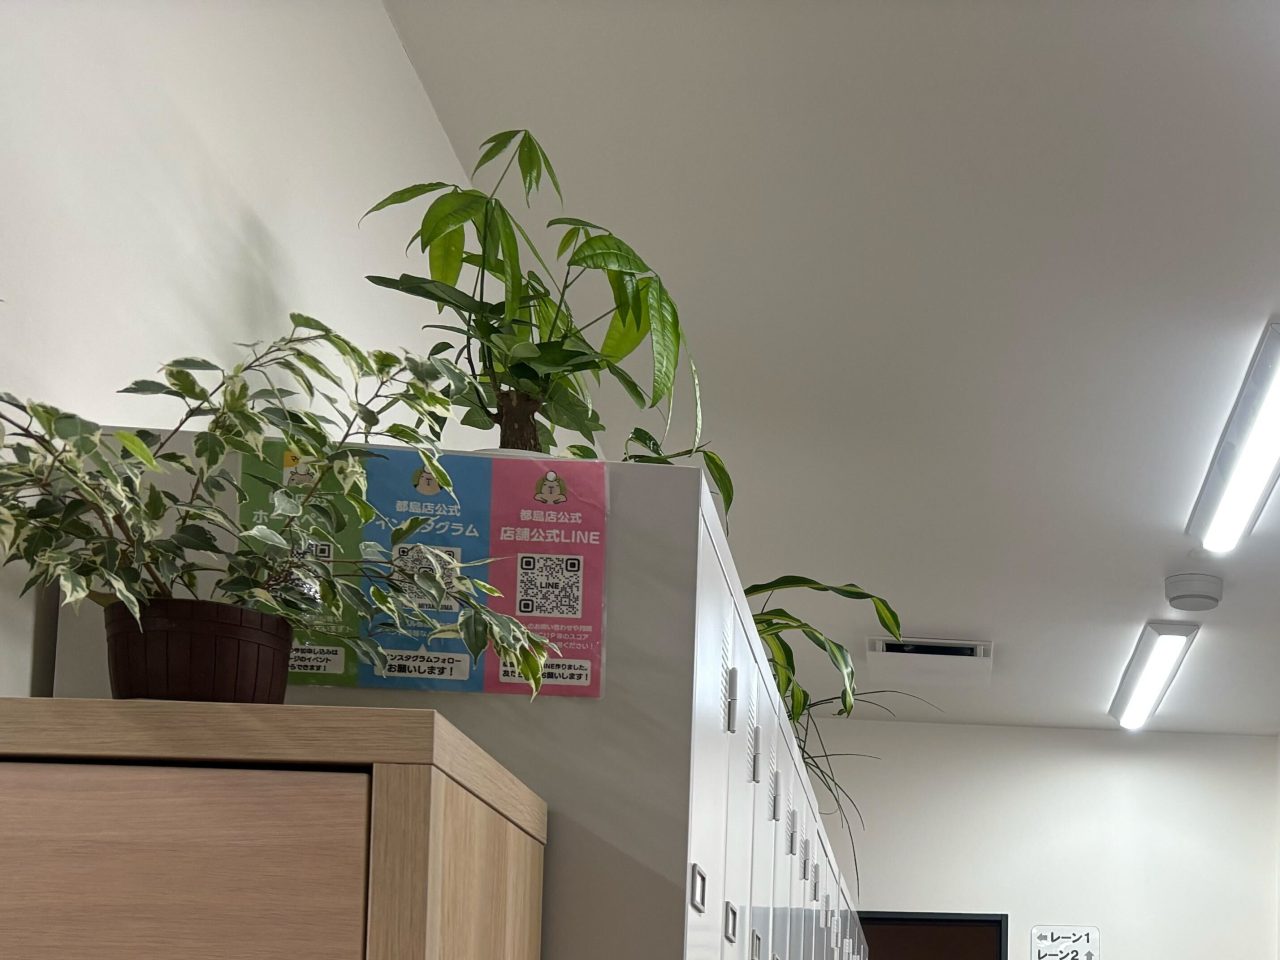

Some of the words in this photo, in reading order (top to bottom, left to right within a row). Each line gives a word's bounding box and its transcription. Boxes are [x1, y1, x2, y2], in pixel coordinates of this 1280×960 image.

[520, 509, 583, 524] 都島店公式
[500, 526, 601, 544] 店舗公式LINE
[387, 653, 462, 664] ンスタグラムフォロー
[1050, 931, 1090, 944] レーン1
[1037, 949, 1079, 960] レーン2
